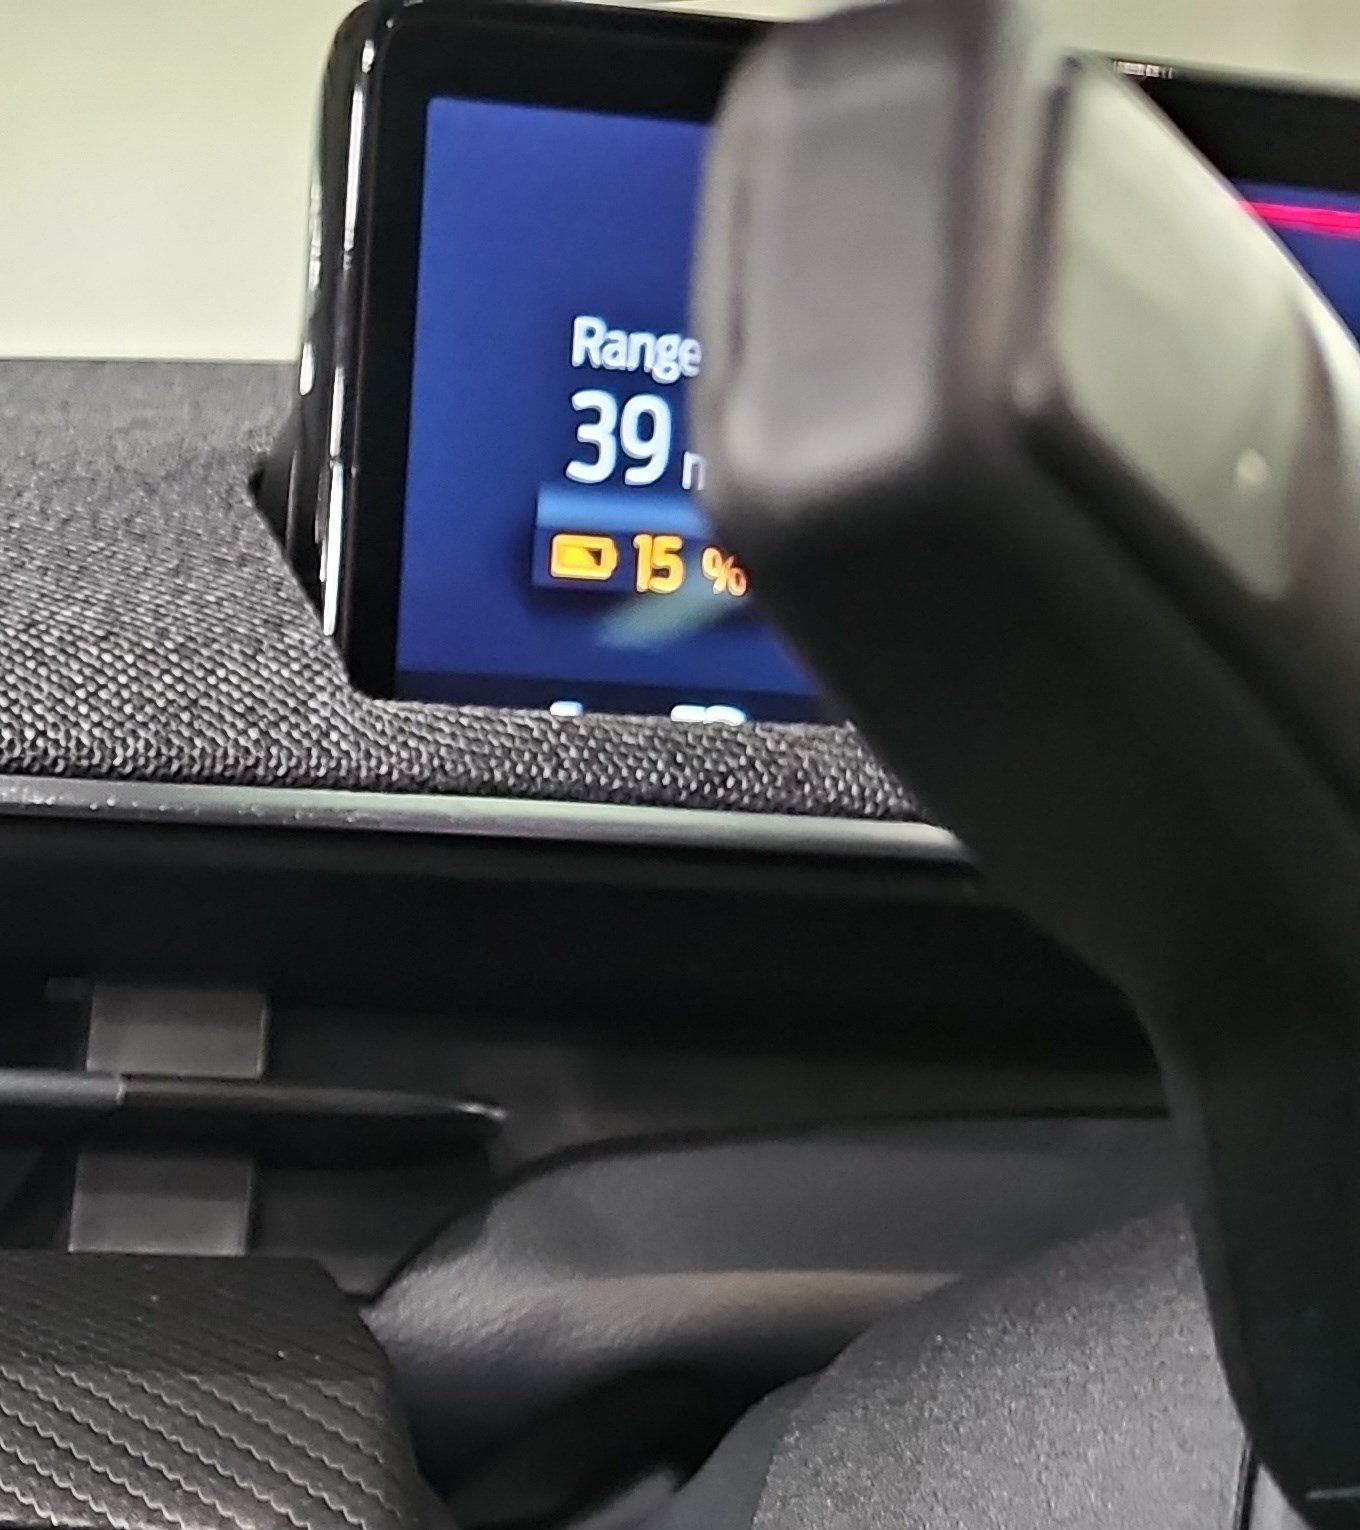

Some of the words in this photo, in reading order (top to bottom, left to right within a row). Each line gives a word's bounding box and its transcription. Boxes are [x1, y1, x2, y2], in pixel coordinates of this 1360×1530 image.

[571, 316, 702, 383] Range
[565, 390, 673, 486] 39
[633, 534, 686, 594] 15
[701, 548, 748, 596] %
